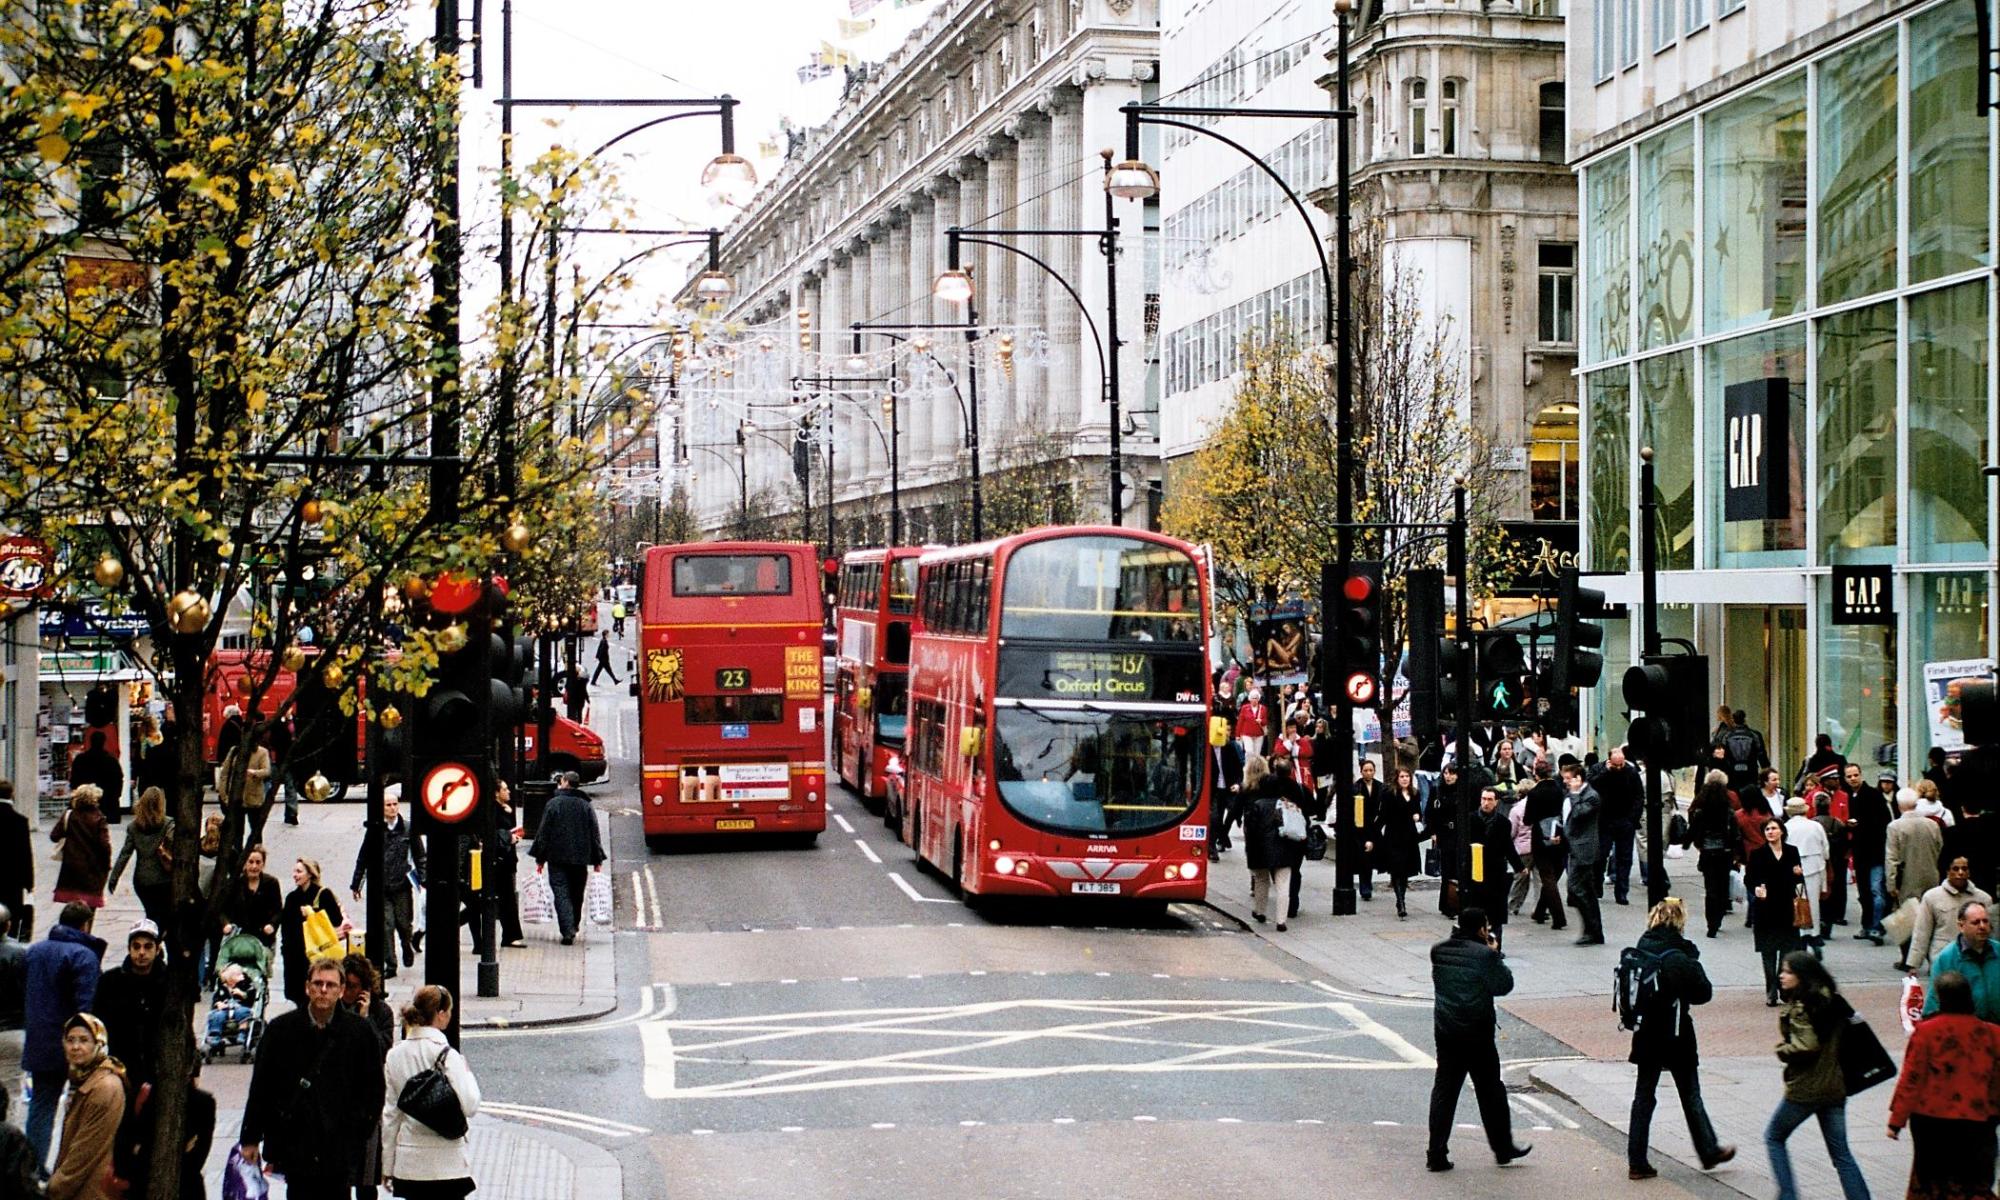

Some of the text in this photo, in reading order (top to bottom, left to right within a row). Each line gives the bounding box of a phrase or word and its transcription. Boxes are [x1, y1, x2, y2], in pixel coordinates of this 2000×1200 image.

[1730, 413, 1761, 489] GAP
[1845, 577, 1881, 605] GAP
[791, 651, 814, 662] THE
[1122, 653, 1145, 674] 137
[787, 665, 819, 676] LION
[1948, 664, 1977, 675] Burger
[723, 670, 744, 688] 23
[787, 679, 820, 690] KING
[1056, 678, 1145, 693] Oxford Circus
[1087, 845, 1118, 853] ARRIVA
[1079, 883, 1114, 892] WLT 385
